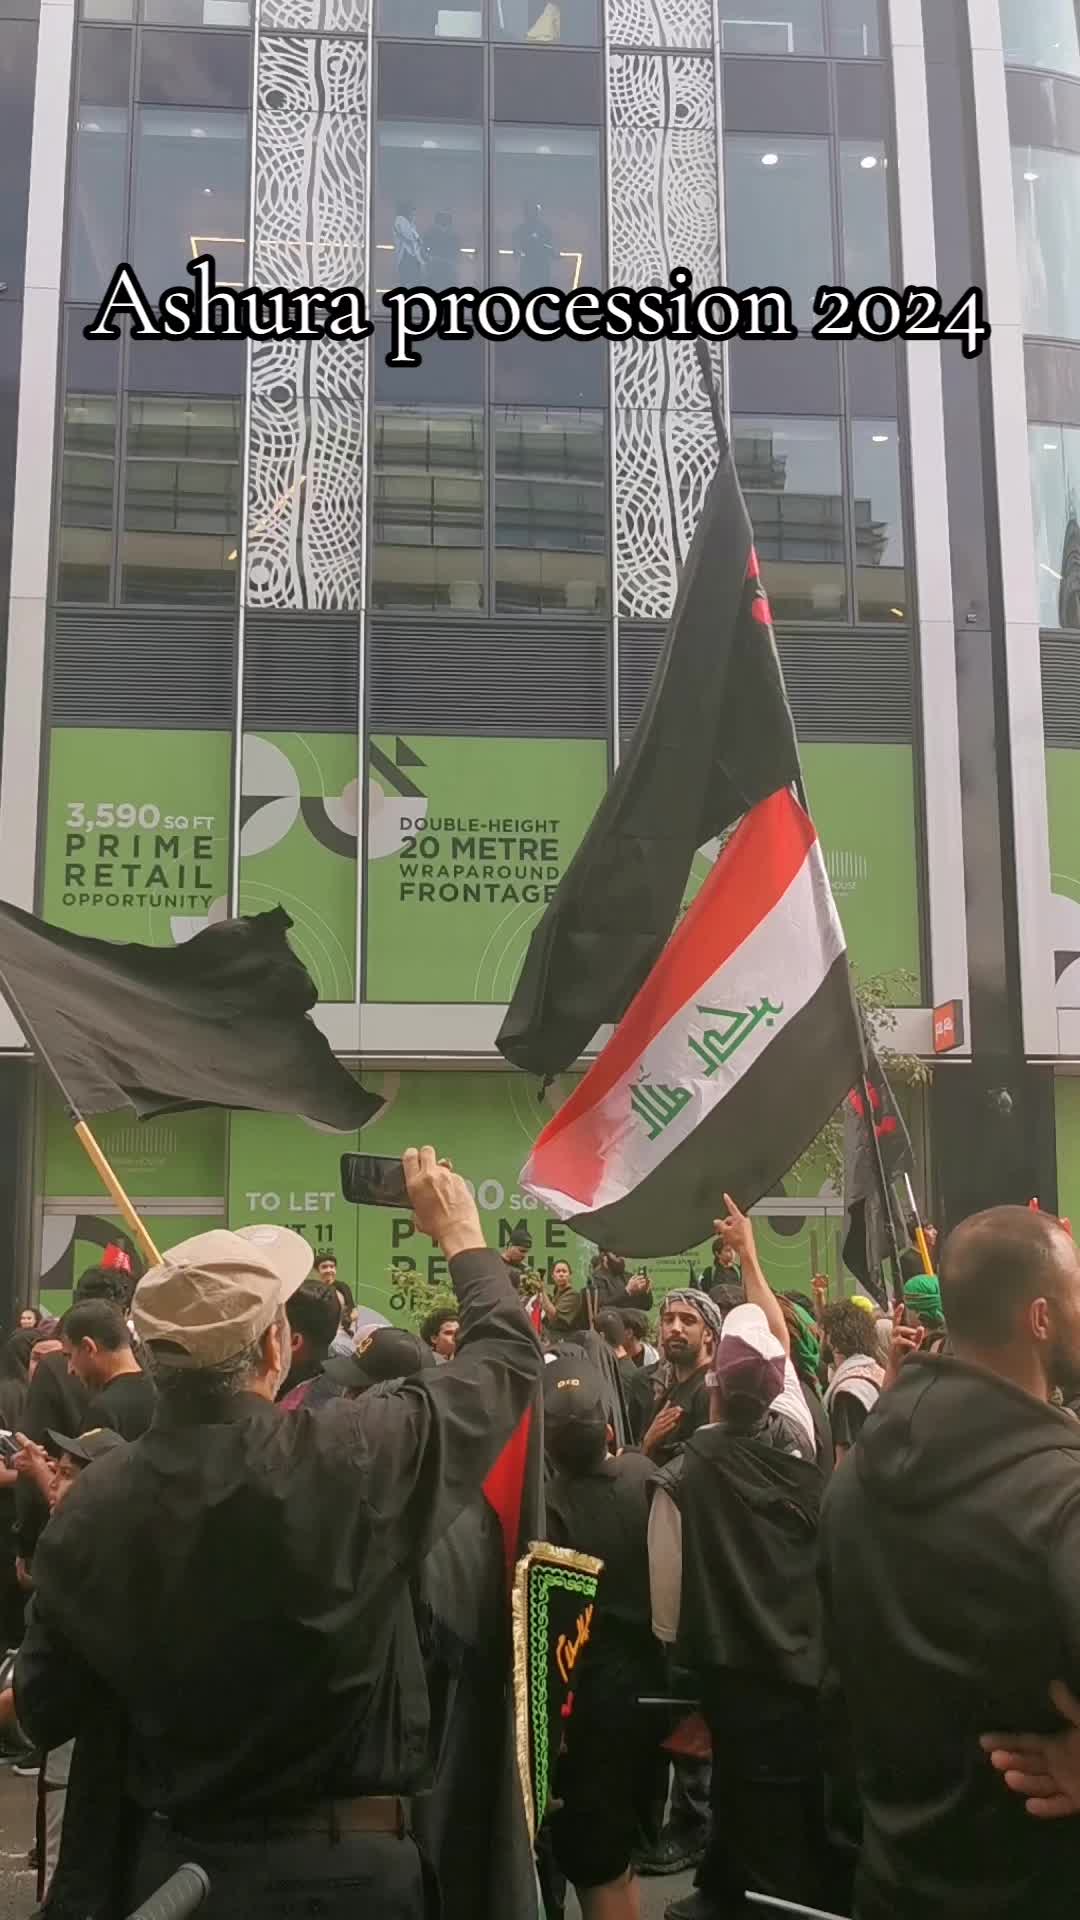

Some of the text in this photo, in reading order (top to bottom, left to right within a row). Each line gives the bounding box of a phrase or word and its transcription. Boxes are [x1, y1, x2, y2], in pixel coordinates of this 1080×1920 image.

[65, 802, 215, 832] 3,590 SQ FT
[400, 817, 560, 833] DOUBLE-HEIGHT
[65, 833, 213, 860] PRIME
[400, 835, 559, 861] 20 METRE
[64, 863, 213, 889] RETAIL
[400, 864, 559, 880] WRAPAROUND
[62, 893, 213, 909] OPPORTUNITY
[400, 882, 559, 904] FRONTAGE
[245, 1191, 336, 1212] TO LET
[314, 1223, 333, 1243] 11
[392, 1218, 568, 1249] PME
